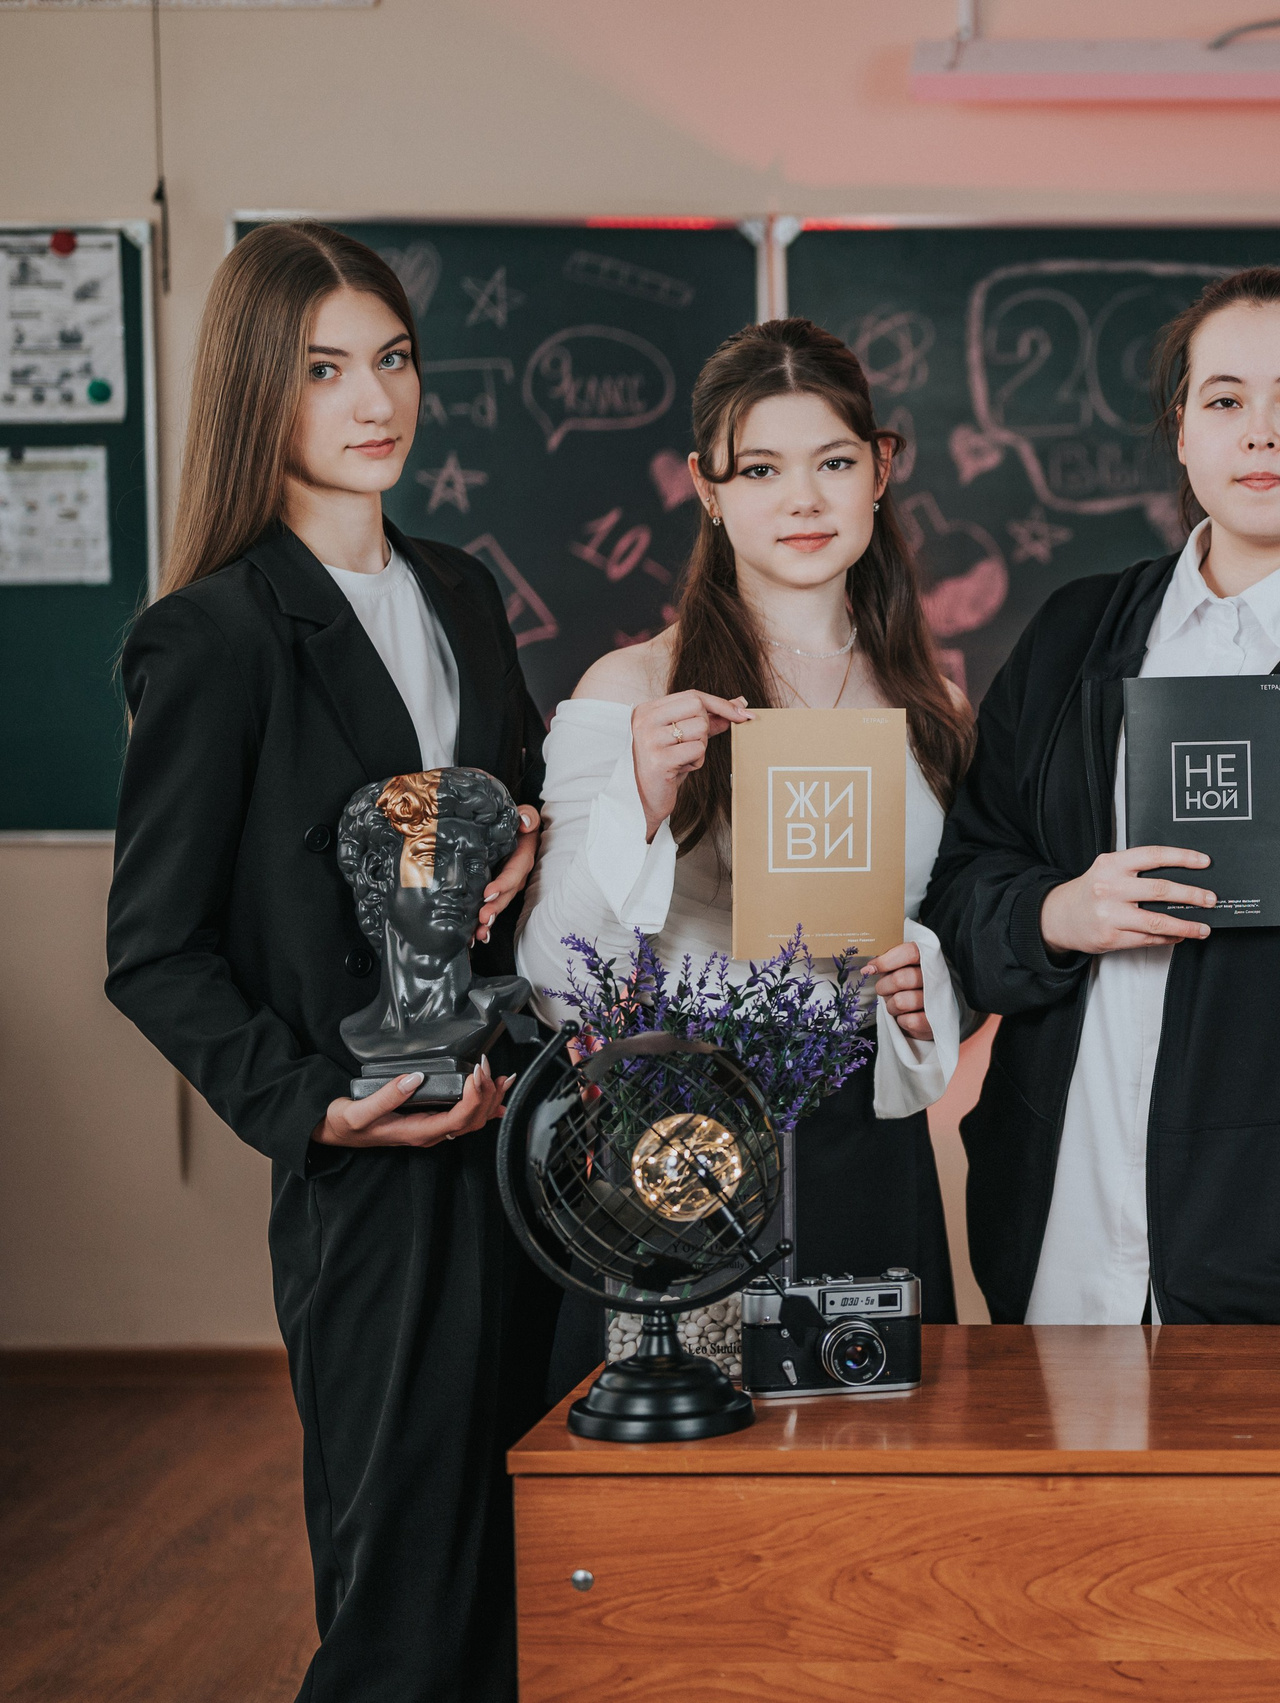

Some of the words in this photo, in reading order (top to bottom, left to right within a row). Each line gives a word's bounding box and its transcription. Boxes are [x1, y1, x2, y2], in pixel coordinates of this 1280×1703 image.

[1185, 754, 1238, 787] НЕ
[784, 781, 854, 818] ЖИ
[1185, 789, 1238, 810] НОЙ
[786, 823, 853, 860] ВИ
[688, 1344, 707, 1355] Leo
[710, 1342, 742, 1354] Studio
